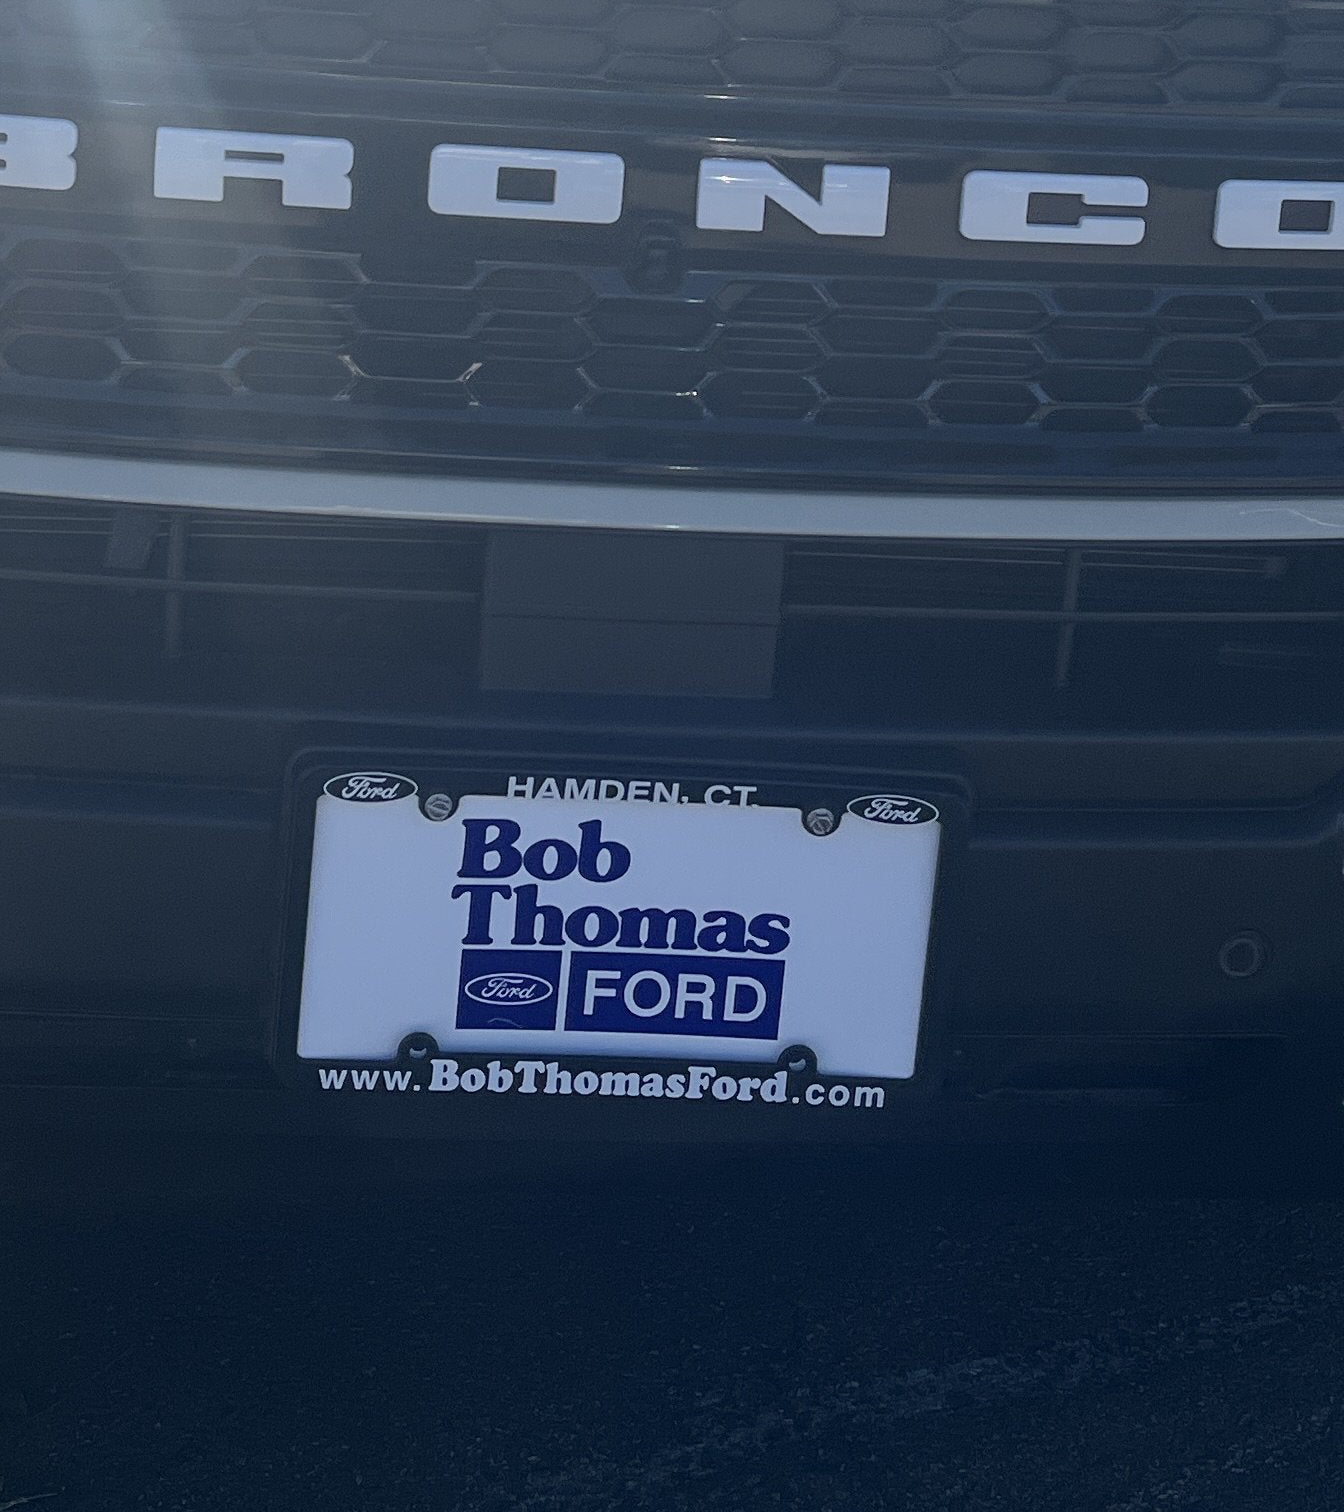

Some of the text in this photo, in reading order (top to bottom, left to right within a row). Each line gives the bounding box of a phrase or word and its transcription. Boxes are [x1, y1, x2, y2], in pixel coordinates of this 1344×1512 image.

[340, 776, 398, 801] Ford
[863, 797, 920, 824] Ford
[457, 818, 631, 883] Bob
[451, 884, 791, 955] Thomas
[481, 975, 538, 1001] Ford
[582, 970, 768, 1023] FORD
[318, 1059, 886, 1109] www.BobThomasFord.com
